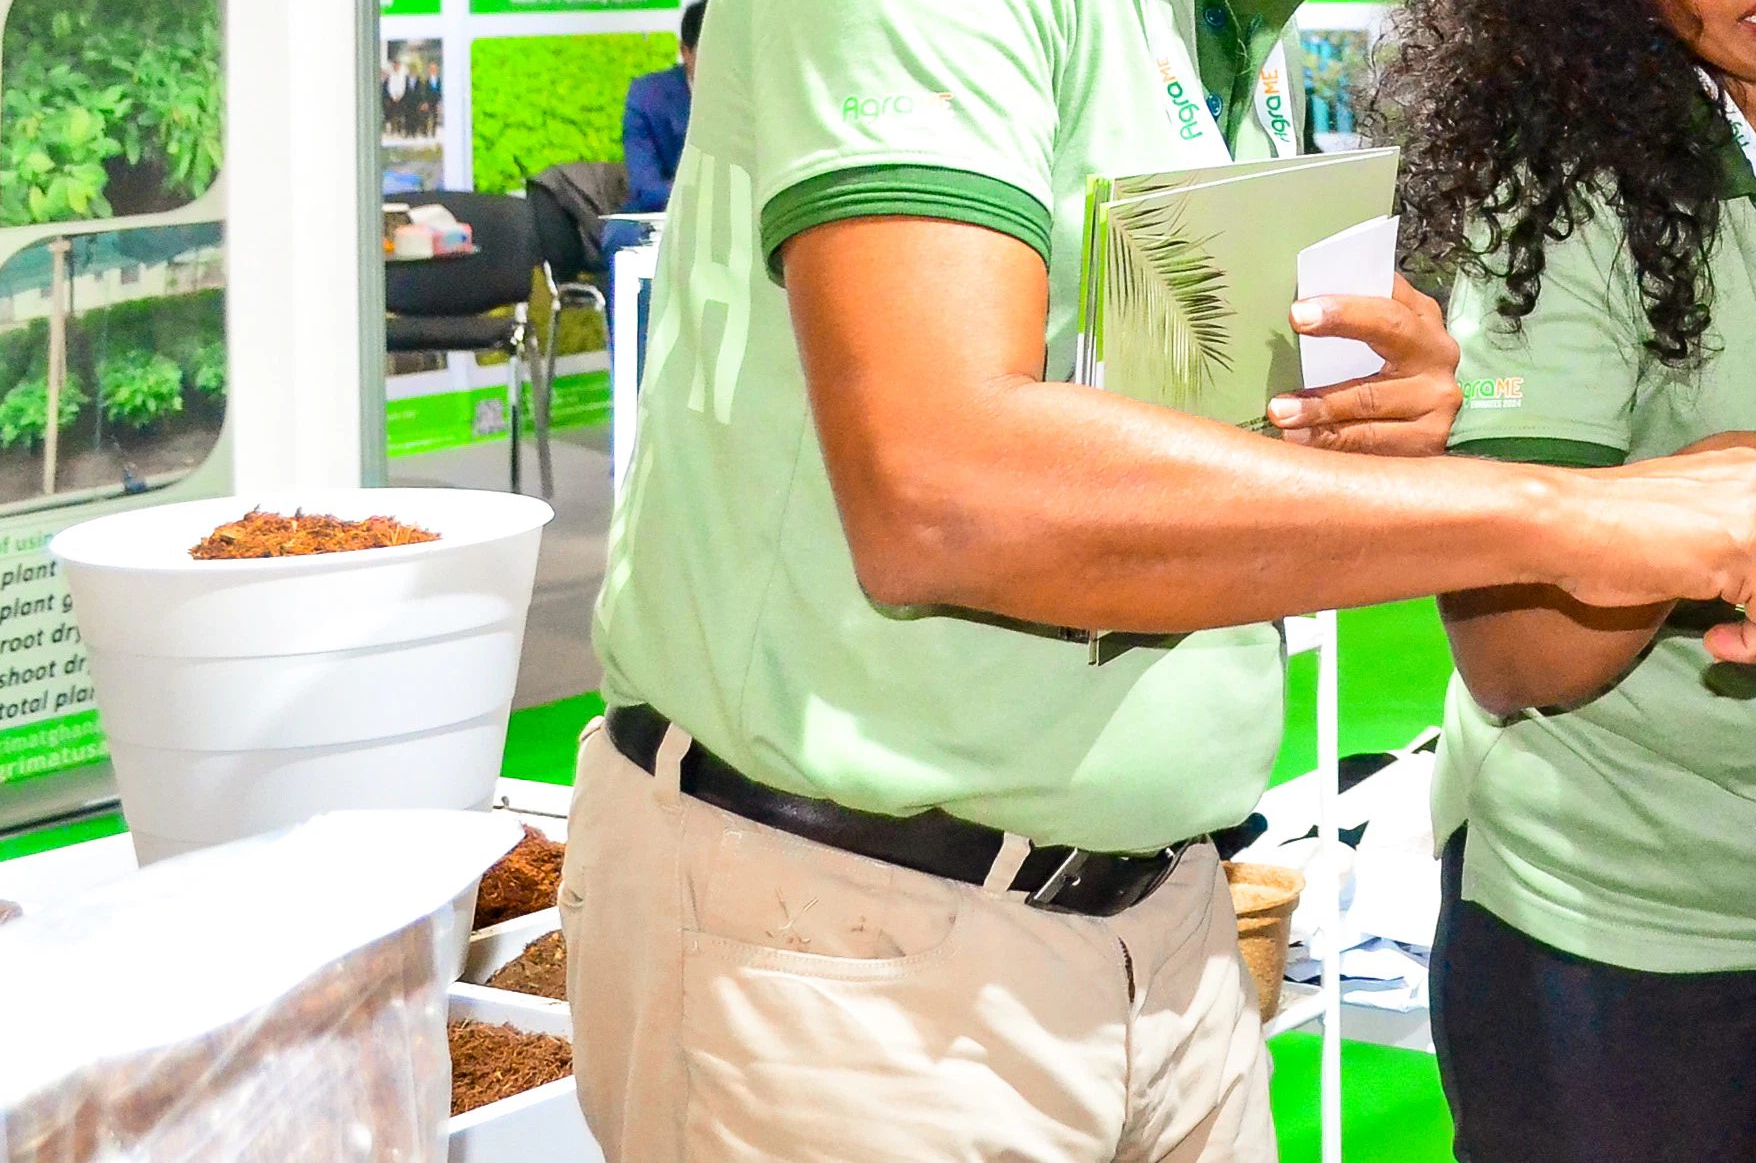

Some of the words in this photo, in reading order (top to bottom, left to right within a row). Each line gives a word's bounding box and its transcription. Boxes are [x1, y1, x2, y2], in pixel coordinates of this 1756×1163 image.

[1157, 56, 1203, 141] AgraME
[1260, 69, 1291, 143] AgraME
[2, 560, 56, 586] plant
[0, 593, 55, 624] plant
[0, 629, 43, 654] root
[64, 654, 90, 676] dr
[0, 690, 48, 720] total
